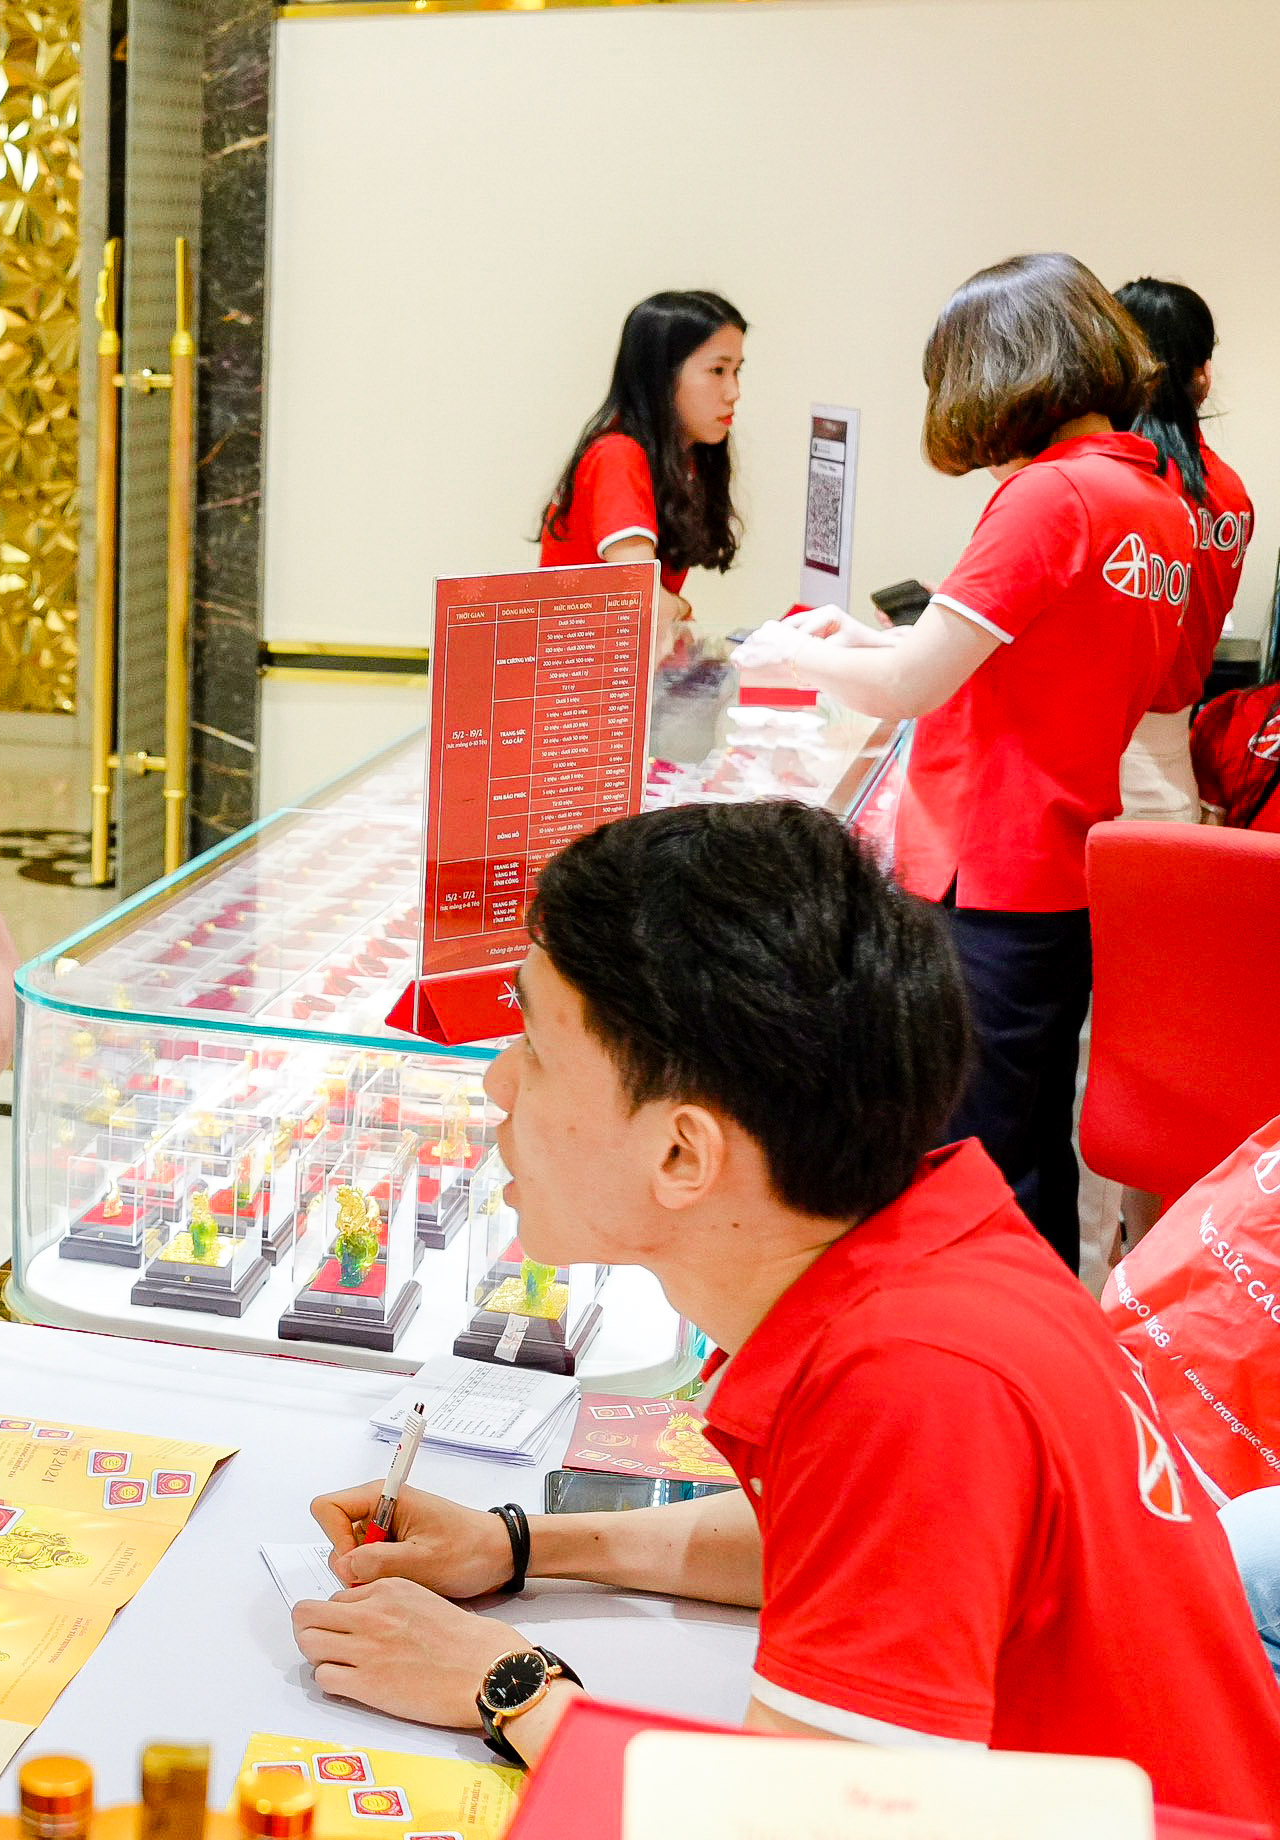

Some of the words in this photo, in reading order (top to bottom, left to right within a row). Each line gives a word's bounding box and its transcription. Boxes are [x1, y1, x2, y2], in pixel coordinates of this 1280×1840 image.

[470, 610, 484, 618] GIAN
[452, 730, 464, 739] 15/2
[469, 729, 482, 737] 19/2
[445, 892, 457, 902] 15/2
[463, 890, 475, 899] 17/2
[1212, 1241, 1252, 1283] SỨC
[1144, 1314, 1170, 1348] 1168
